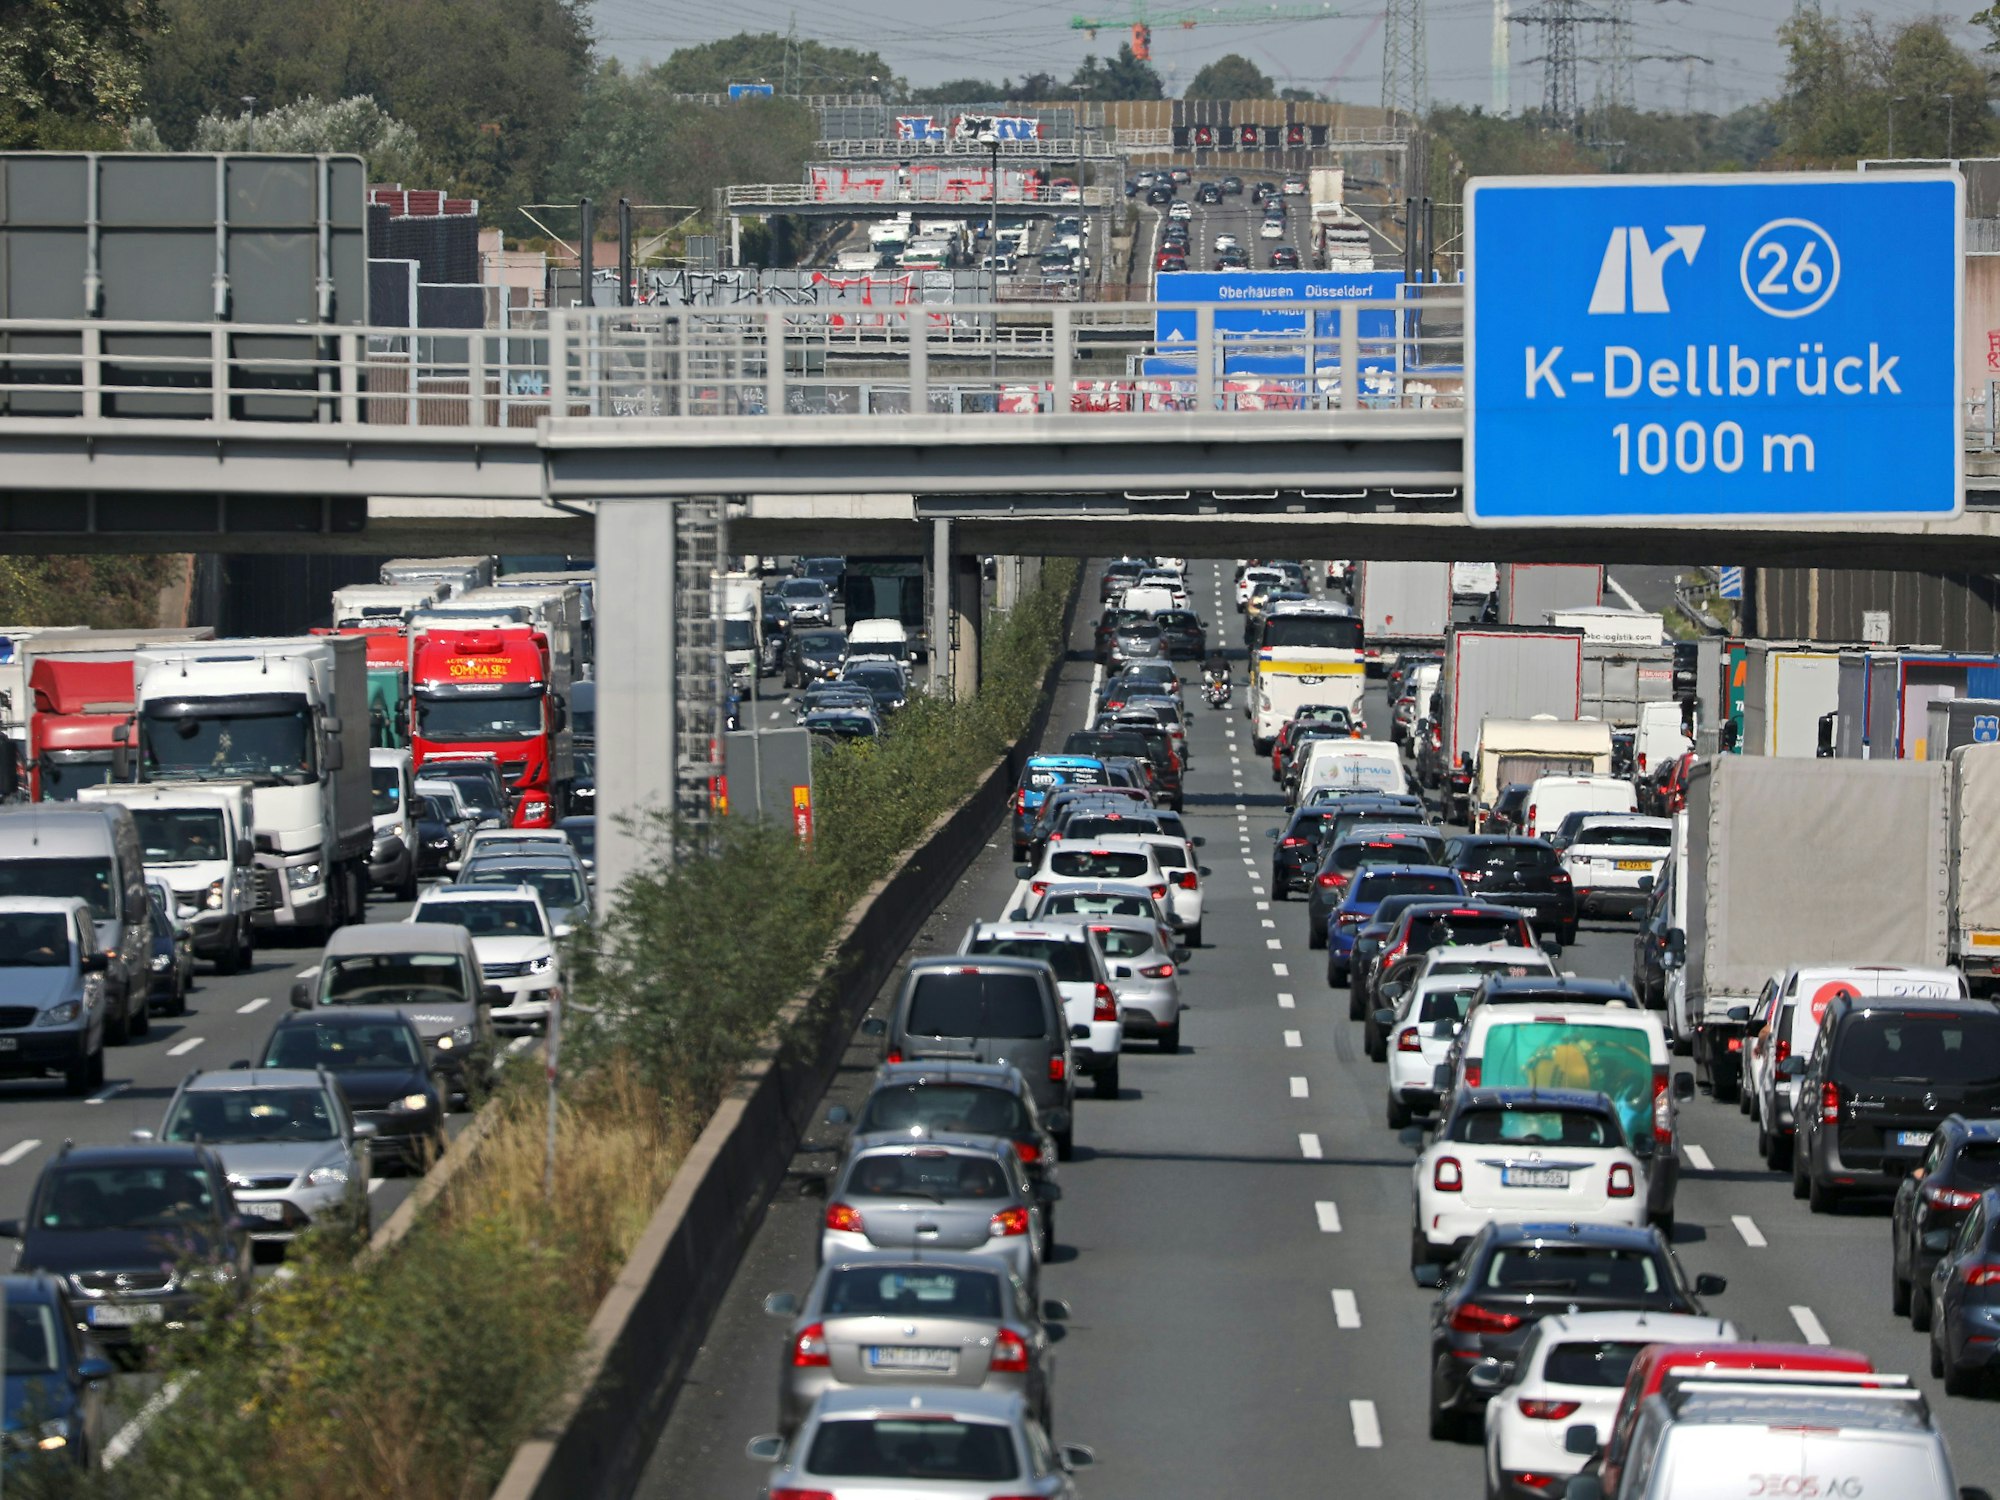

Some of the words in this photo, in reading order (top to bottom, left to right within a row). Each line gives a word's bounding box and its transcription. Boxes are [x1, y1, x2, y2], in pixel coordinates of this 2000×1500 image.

[1219, 285, 1295, 299] Oberhausen
[1305, 284, 1374, 298] Düsseldorf
[1757, 241, 1823, 295] 26
[1525, 342, 1902, 399] K-Dellbrück
[1612, 420, 1744, 476] 1000
[1762, 433, 1815, 473] m
[450, 664, 489, 676] SOMMA
[490, 664, 508, 675] SRL
